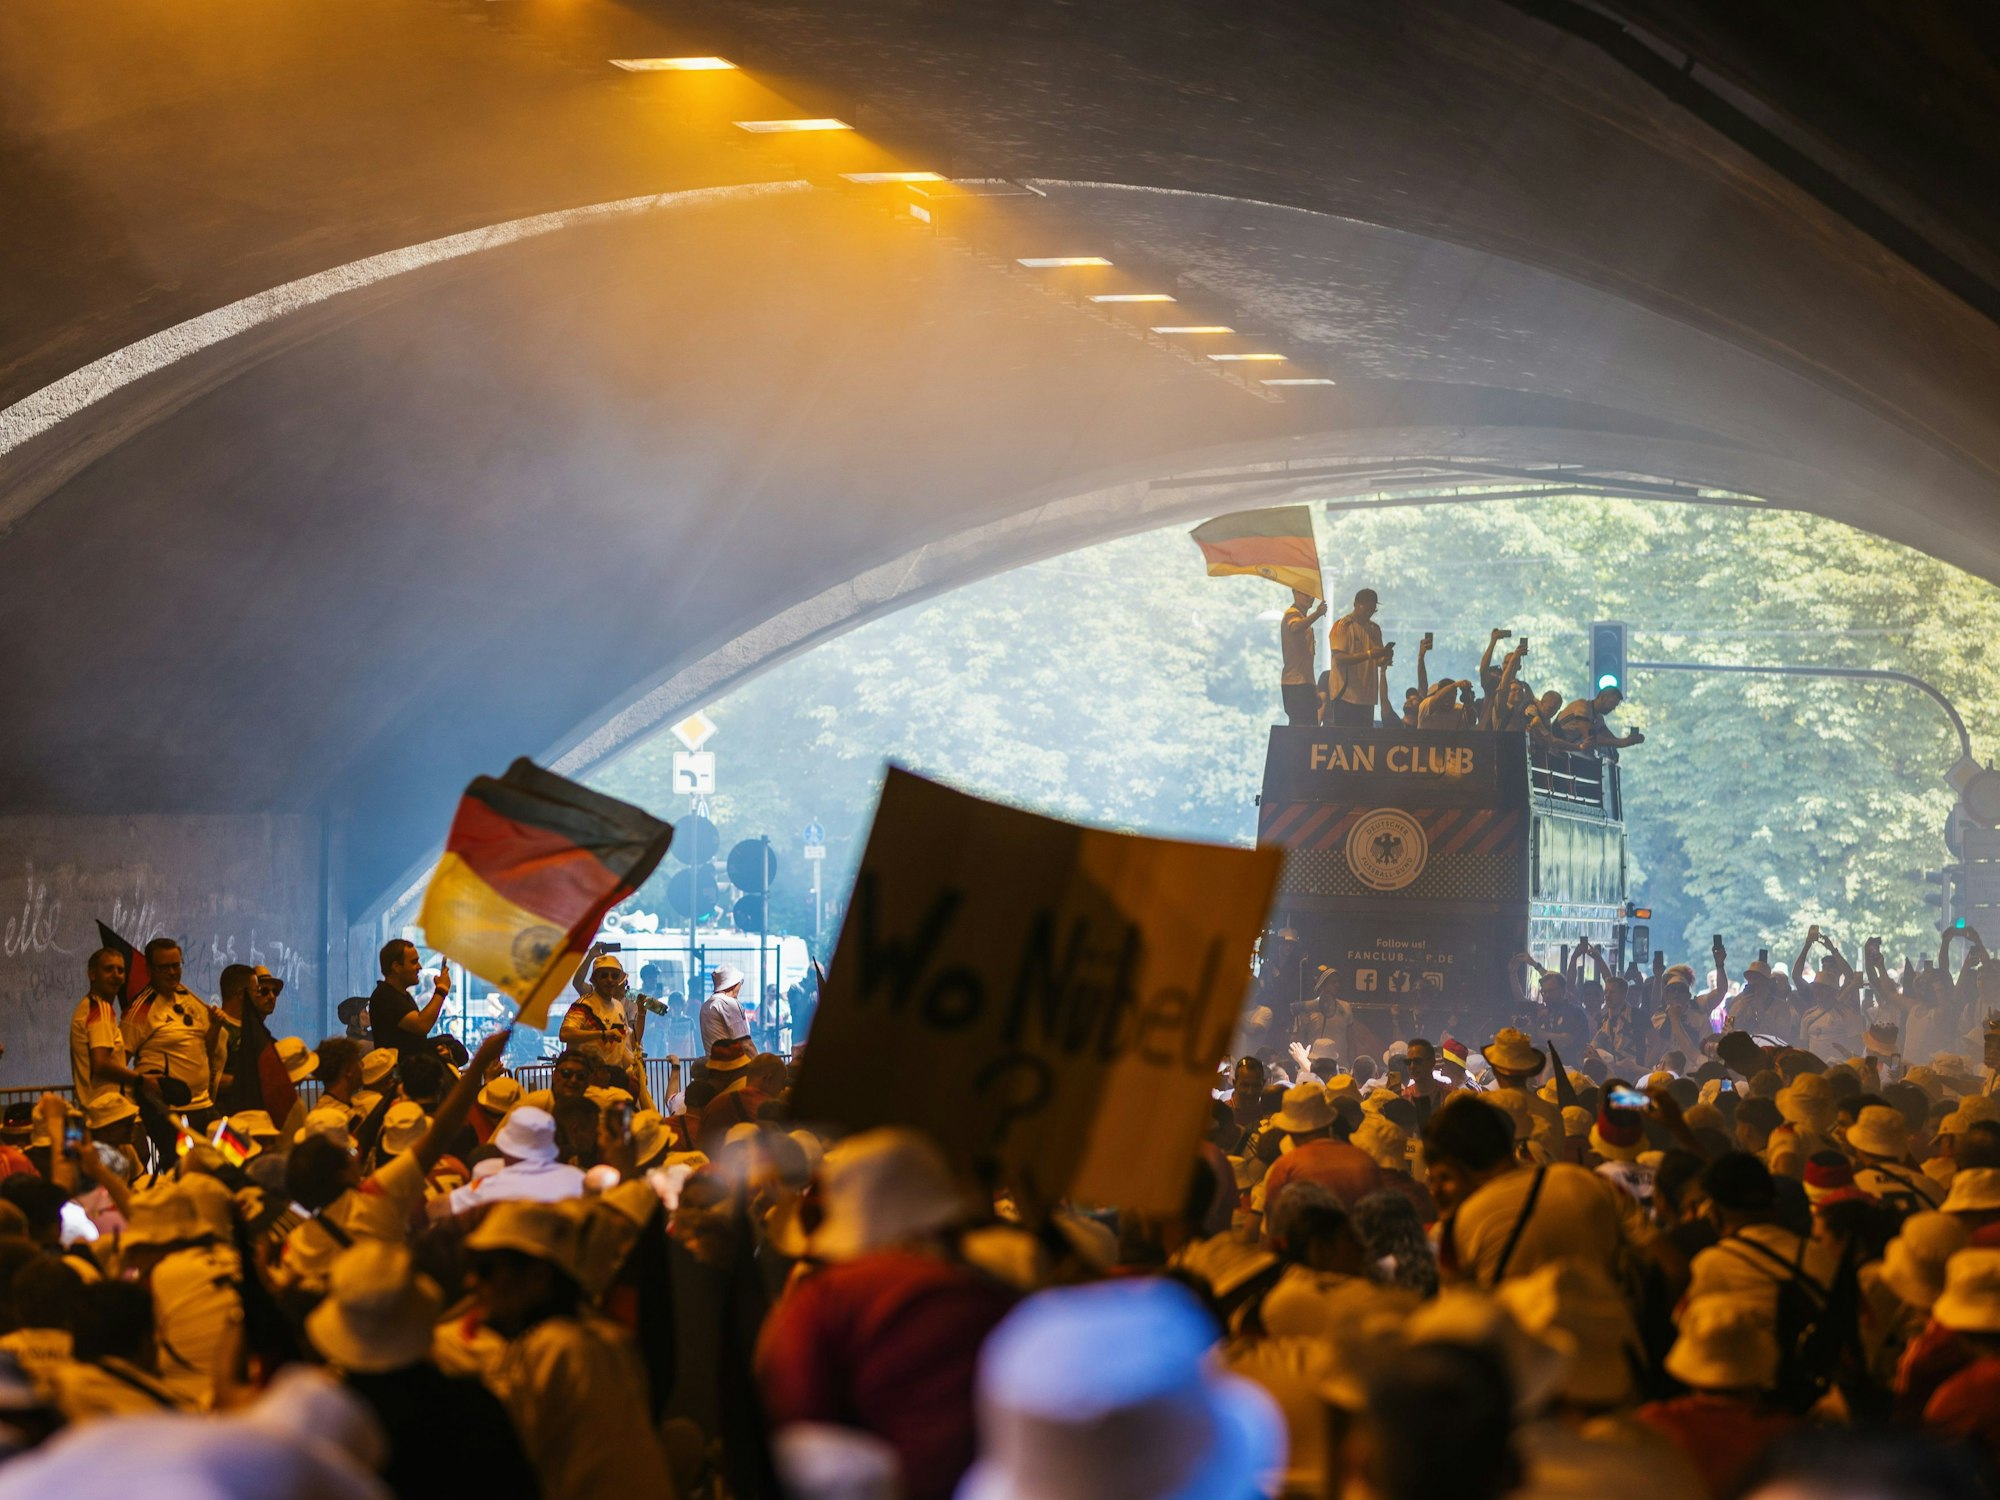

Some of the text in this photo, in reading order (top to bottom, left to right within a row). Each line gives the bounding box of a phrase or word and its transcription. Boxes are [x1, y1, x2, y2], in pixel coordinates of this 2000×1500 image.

[1310, 743, 1475, 774] FAN CLUB
[1366, 822, 1409, 838] DEUTSCHER
[856, 868, 984, 1029] Wo
[1376, 938, 1426, 950] Follow us!
